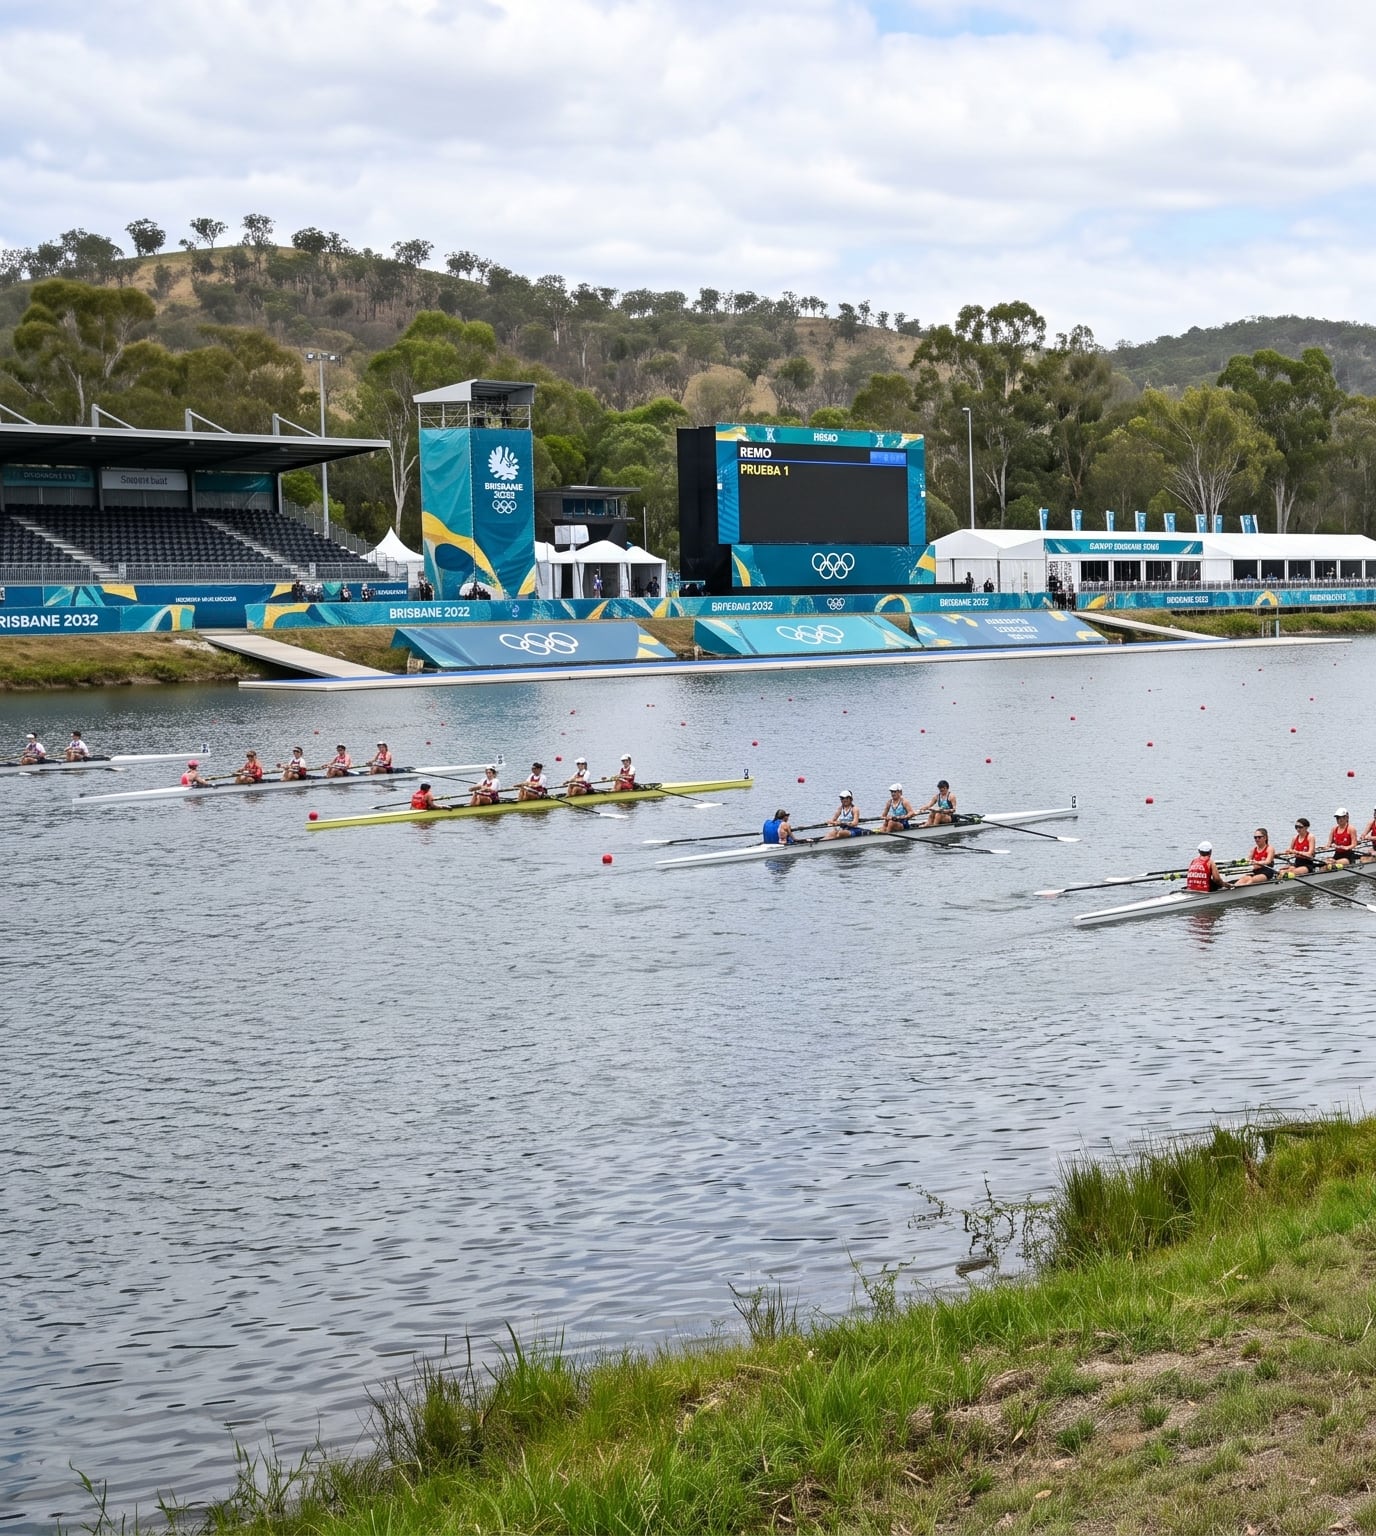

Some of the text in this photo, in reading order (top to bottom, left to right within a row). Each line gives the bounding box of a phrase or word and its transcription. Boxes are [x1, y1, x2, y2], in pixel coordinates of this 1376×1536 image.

[740, 447, 772, 459] REMO
[740, 463, 789, 476] PRUEBA 1
[389, 607, 442, 619] BRISBANE
[63, 614, 99, 627] 2032
